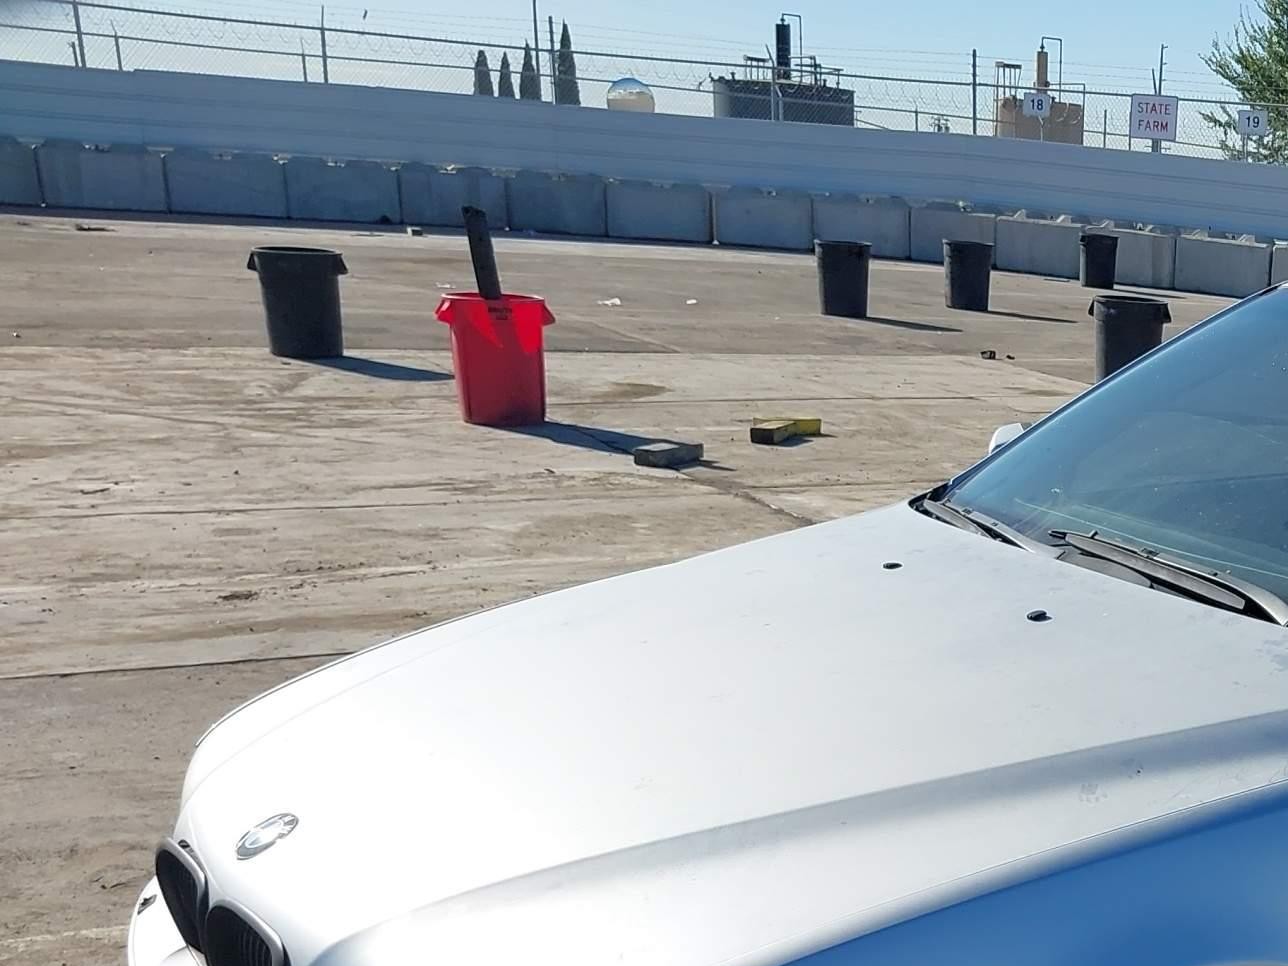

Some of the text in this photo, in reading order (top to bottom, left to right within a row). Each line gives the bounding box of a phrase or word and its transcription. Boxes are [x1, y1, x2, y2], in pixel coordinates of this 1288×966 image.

[1030, 98, 1044, 111] 18
[1137, 103, 1171, 116] STATE
[1137, 119, 1169, 132] FARM
[1245, 116, 1260, 128] 19
